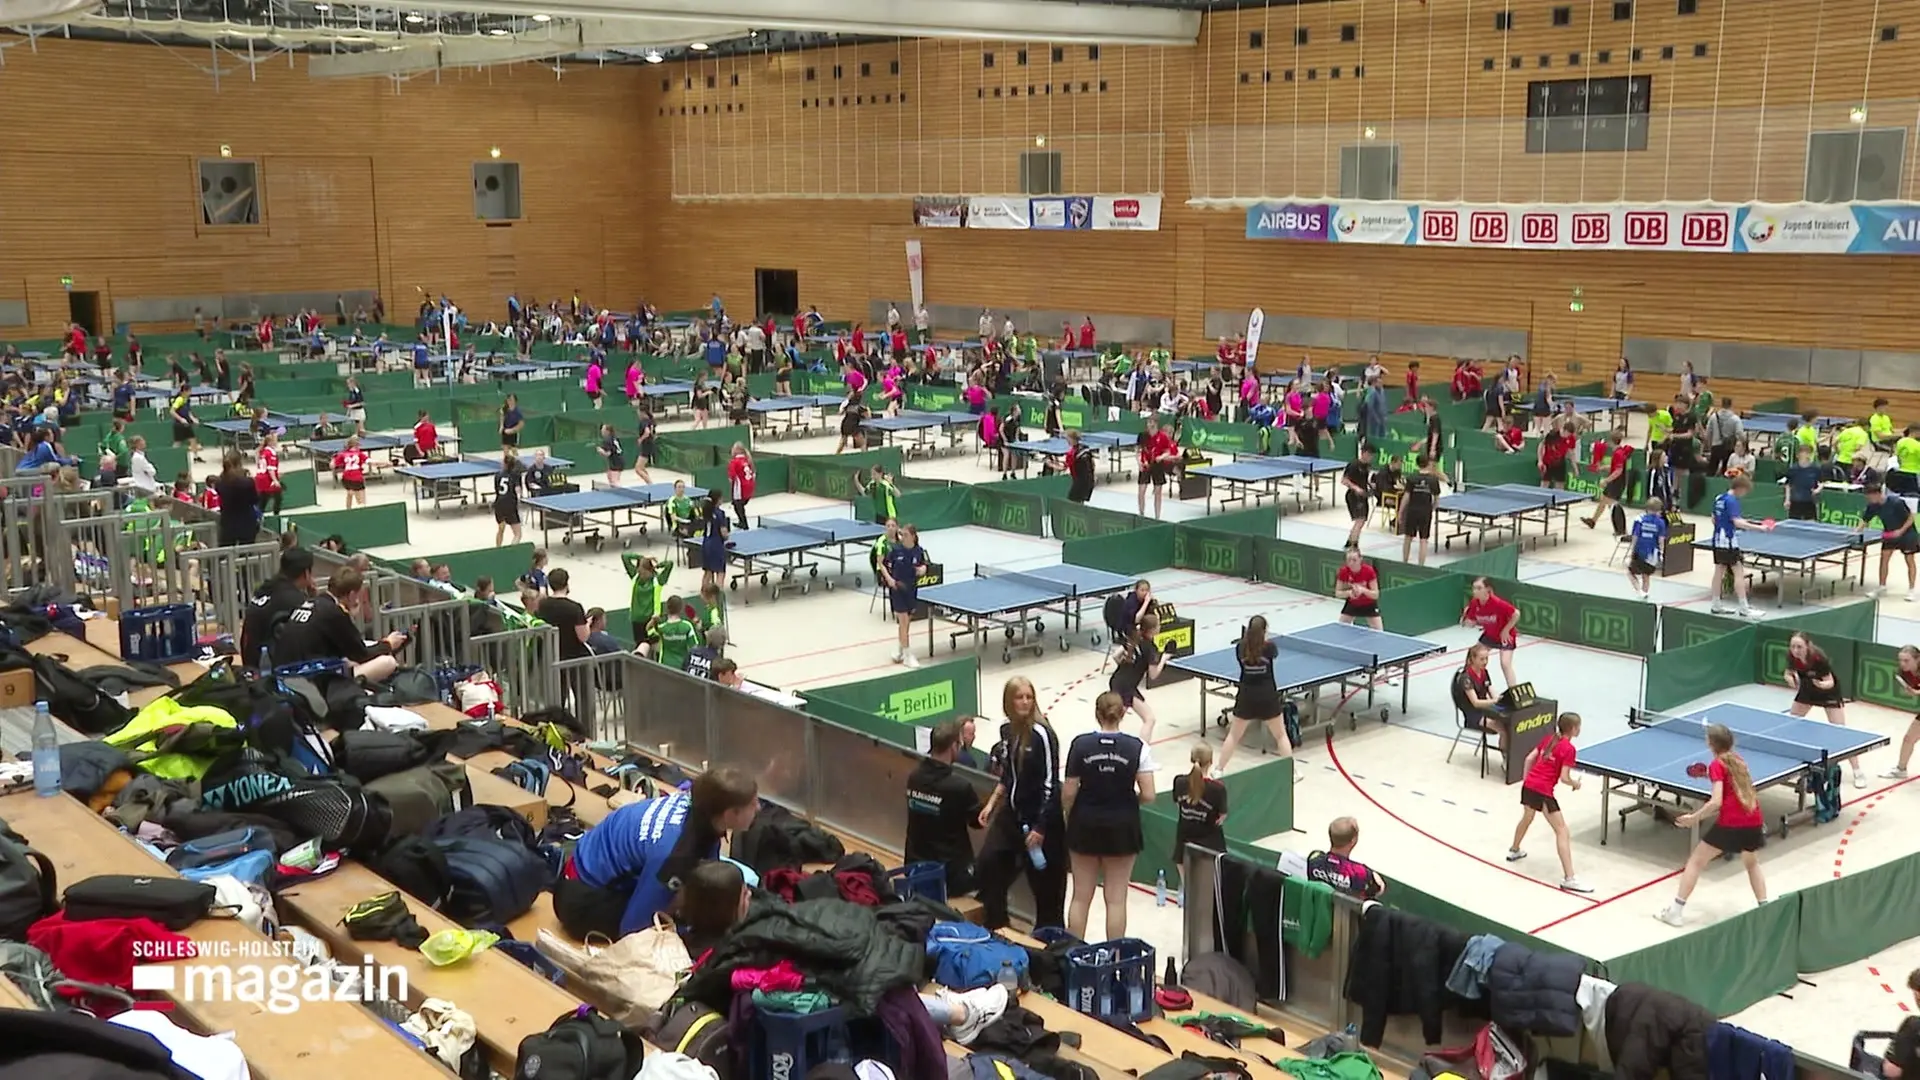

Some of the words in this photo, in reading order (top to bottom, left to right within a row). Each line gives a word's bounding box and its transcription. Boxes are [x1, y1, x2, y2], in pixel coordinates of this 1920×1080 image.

[1257, 207, 1321, 231] AIRBUS
[1427, 215, 1454, 237] DB
[1474, 217, 1504, 238] DB
[1526, 218, 1554, 238] DB
[1577, 218, 1605, 239] DB
[1630, 217, 1663, 240] DB
[1687, 218, 1723, 241] DB
[1783, 220, 1812, 231] Jugend
[1882, 219, 1920, 241] AI
[499, 477, 509, 495] 5
[1207, 546, 1232, 570] DB
[1275, 555, 1300, 581] DB
[916, 575, 938, 587] dro
[1588, 615, 1625, 642] DB
[904, 692, 947, 715] Berlin
[1516, 713, 1552, 733] andro
